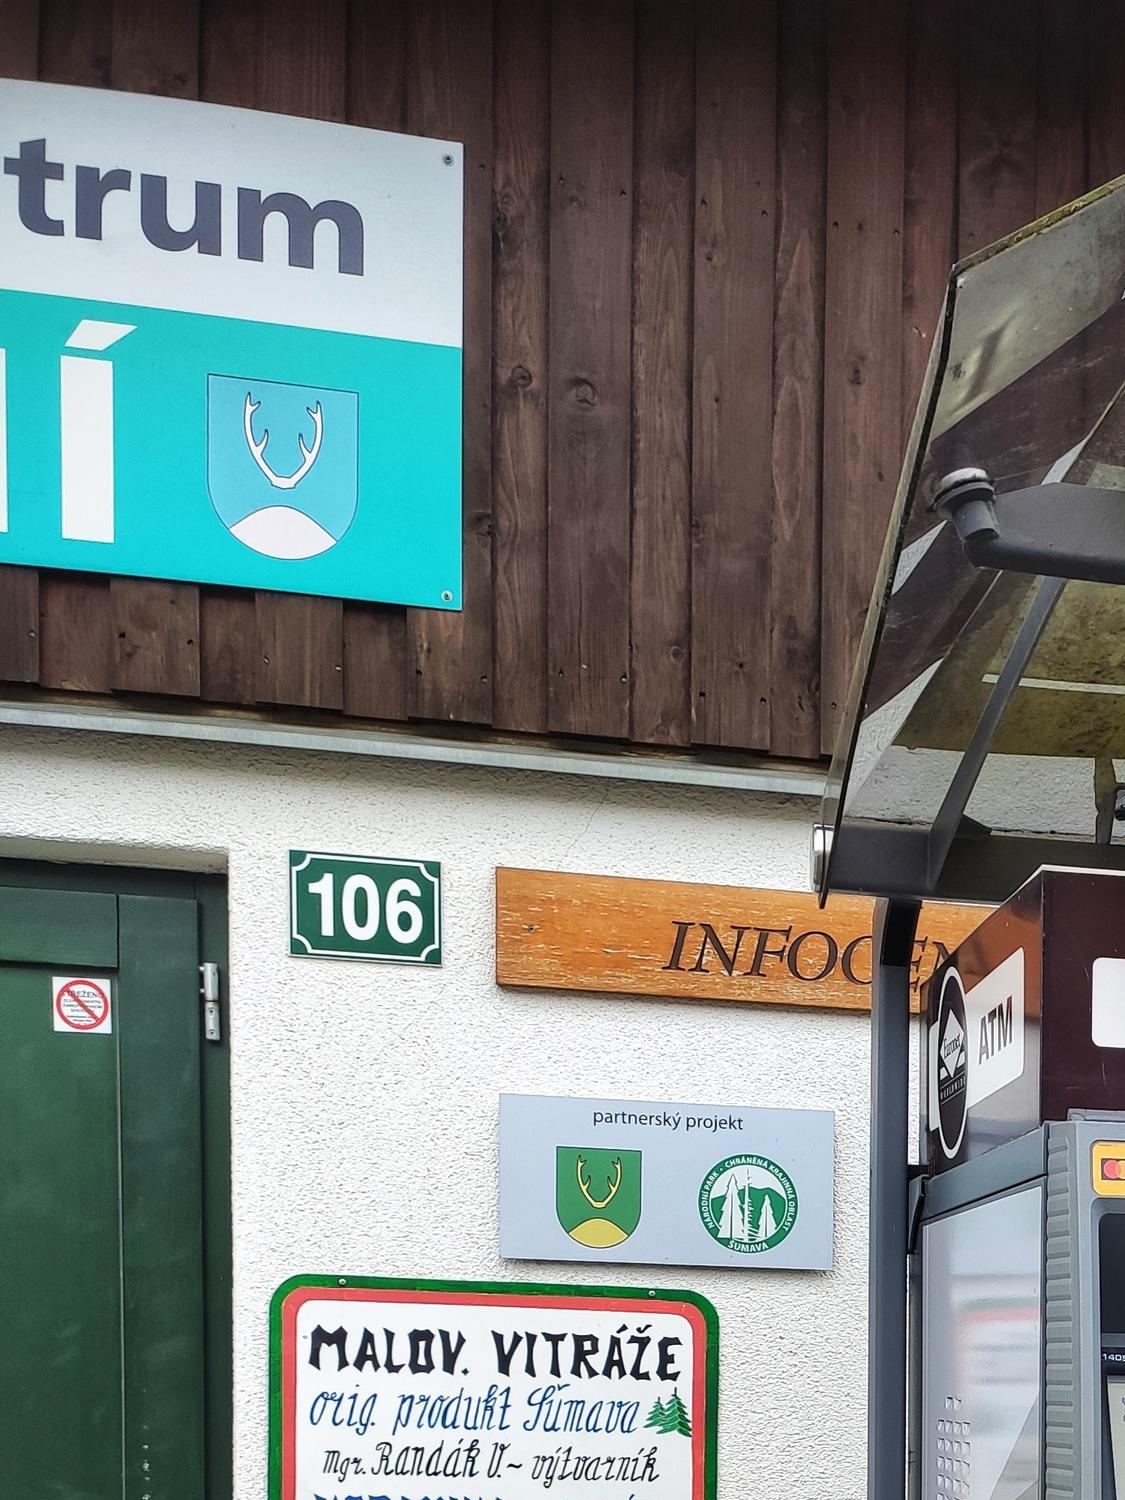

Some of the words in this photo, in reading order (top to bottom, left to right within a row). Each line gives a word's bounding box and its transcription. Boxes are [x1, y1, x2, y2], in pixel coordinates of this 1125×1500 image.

[3, 137, 365, 276] trum
[0, 319, 138, 544] Í
[307, 872, 423, 944] 106
[978, 995, 1012, 1066] ATM
[593, 1111, 681, 1131] partnerský
[686, 1114, 743, 1133] projekt
[703, 1171, 719, 1190] PARK
[308, 1324, 470, 1377] MALOV.
[491, 1324, 683, 1381] VITRÁŽE
[309, 1384, 376, 1435] orig.
[392, 1384, 511, 1435] produkt
[371, 1438, 481, 1479] Randák
